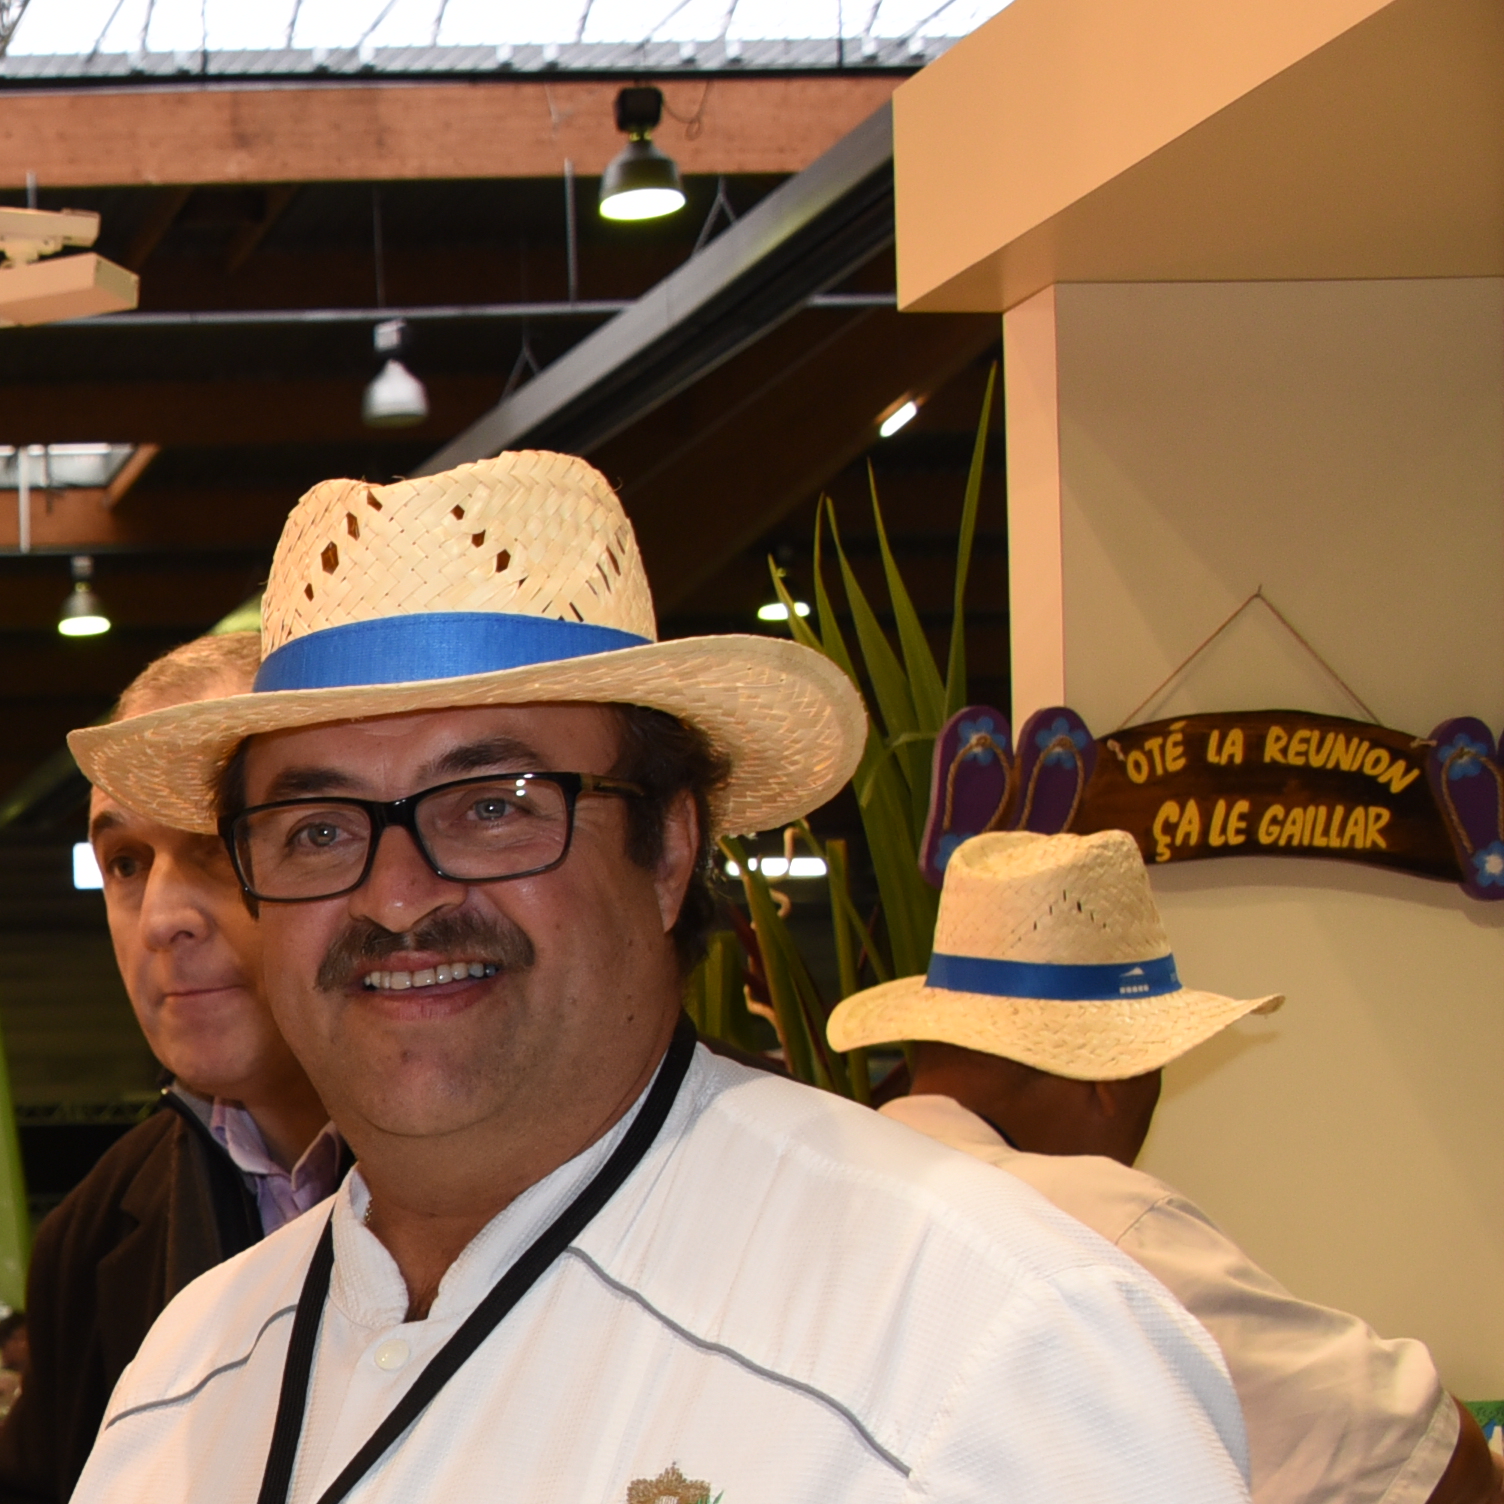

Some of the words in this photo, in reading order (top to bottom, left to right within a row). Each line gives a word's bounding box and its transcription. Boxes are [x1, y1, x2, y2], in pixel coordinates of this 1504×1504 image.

[1125, 720, 1188, 785] OTÉ
[1206, 726, 1244, 766] LA
[1263, 724, 1420, 794] REUNION
[1152, 798, 1200, 862] ÇA
[1209, 799, 1250, 849] LE
[1258, 804, 1391, 850] GAILLAR
